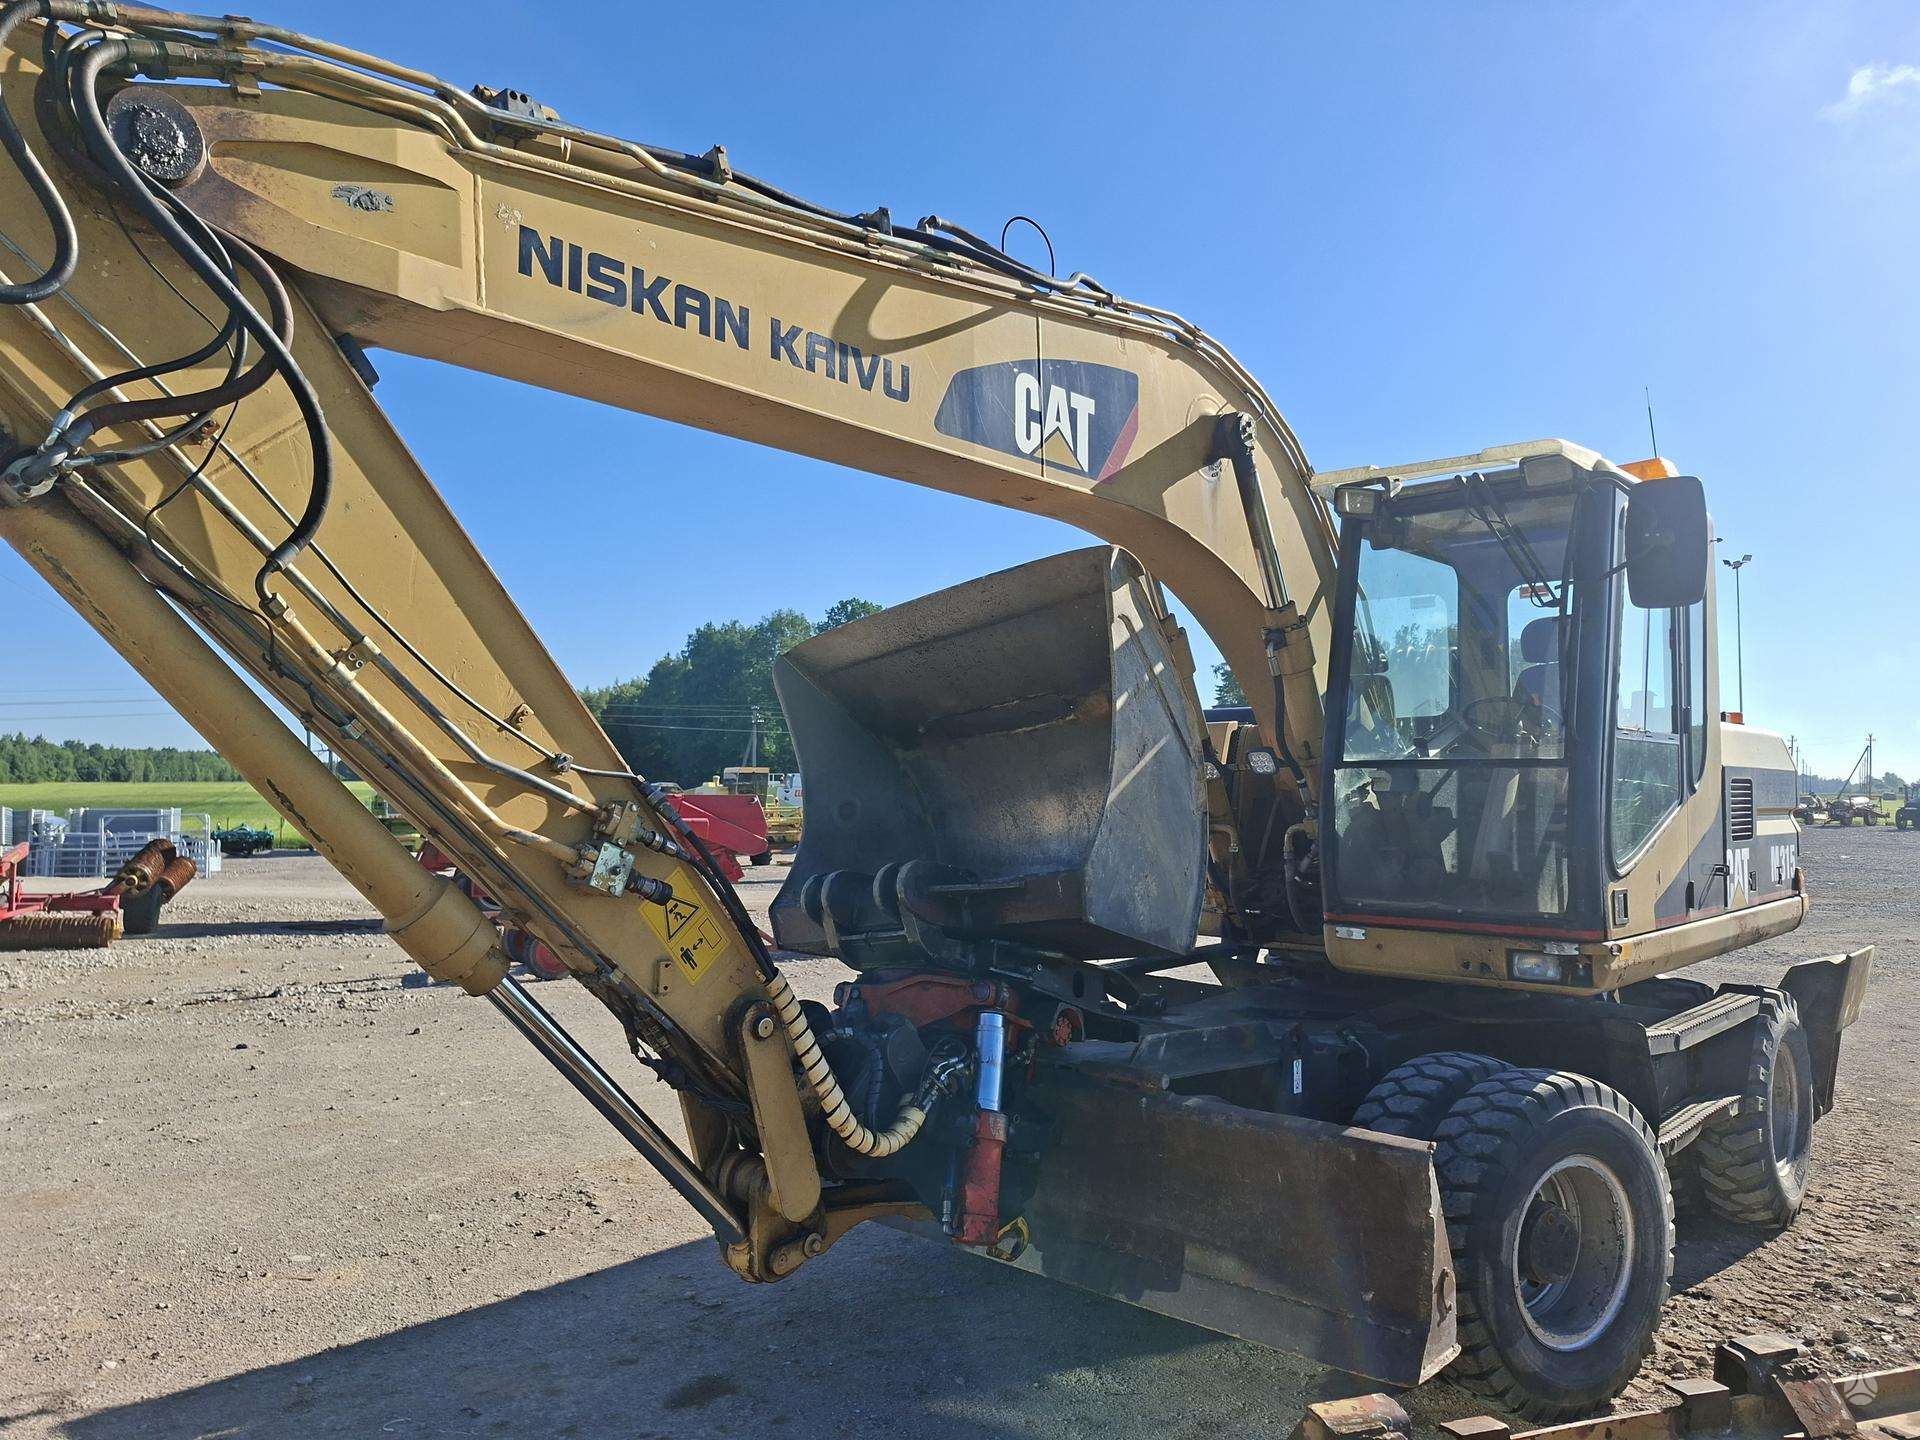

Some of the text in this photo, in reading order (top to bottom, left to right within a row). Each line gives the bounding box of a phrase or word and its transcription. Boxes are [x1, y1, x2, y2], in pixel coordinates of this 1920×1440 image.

[519, 226, 910, 402] NISKAN KAIVU
[1014, 371, 1096, 472] CAT
[1770, 845, 1796, 882] M315
